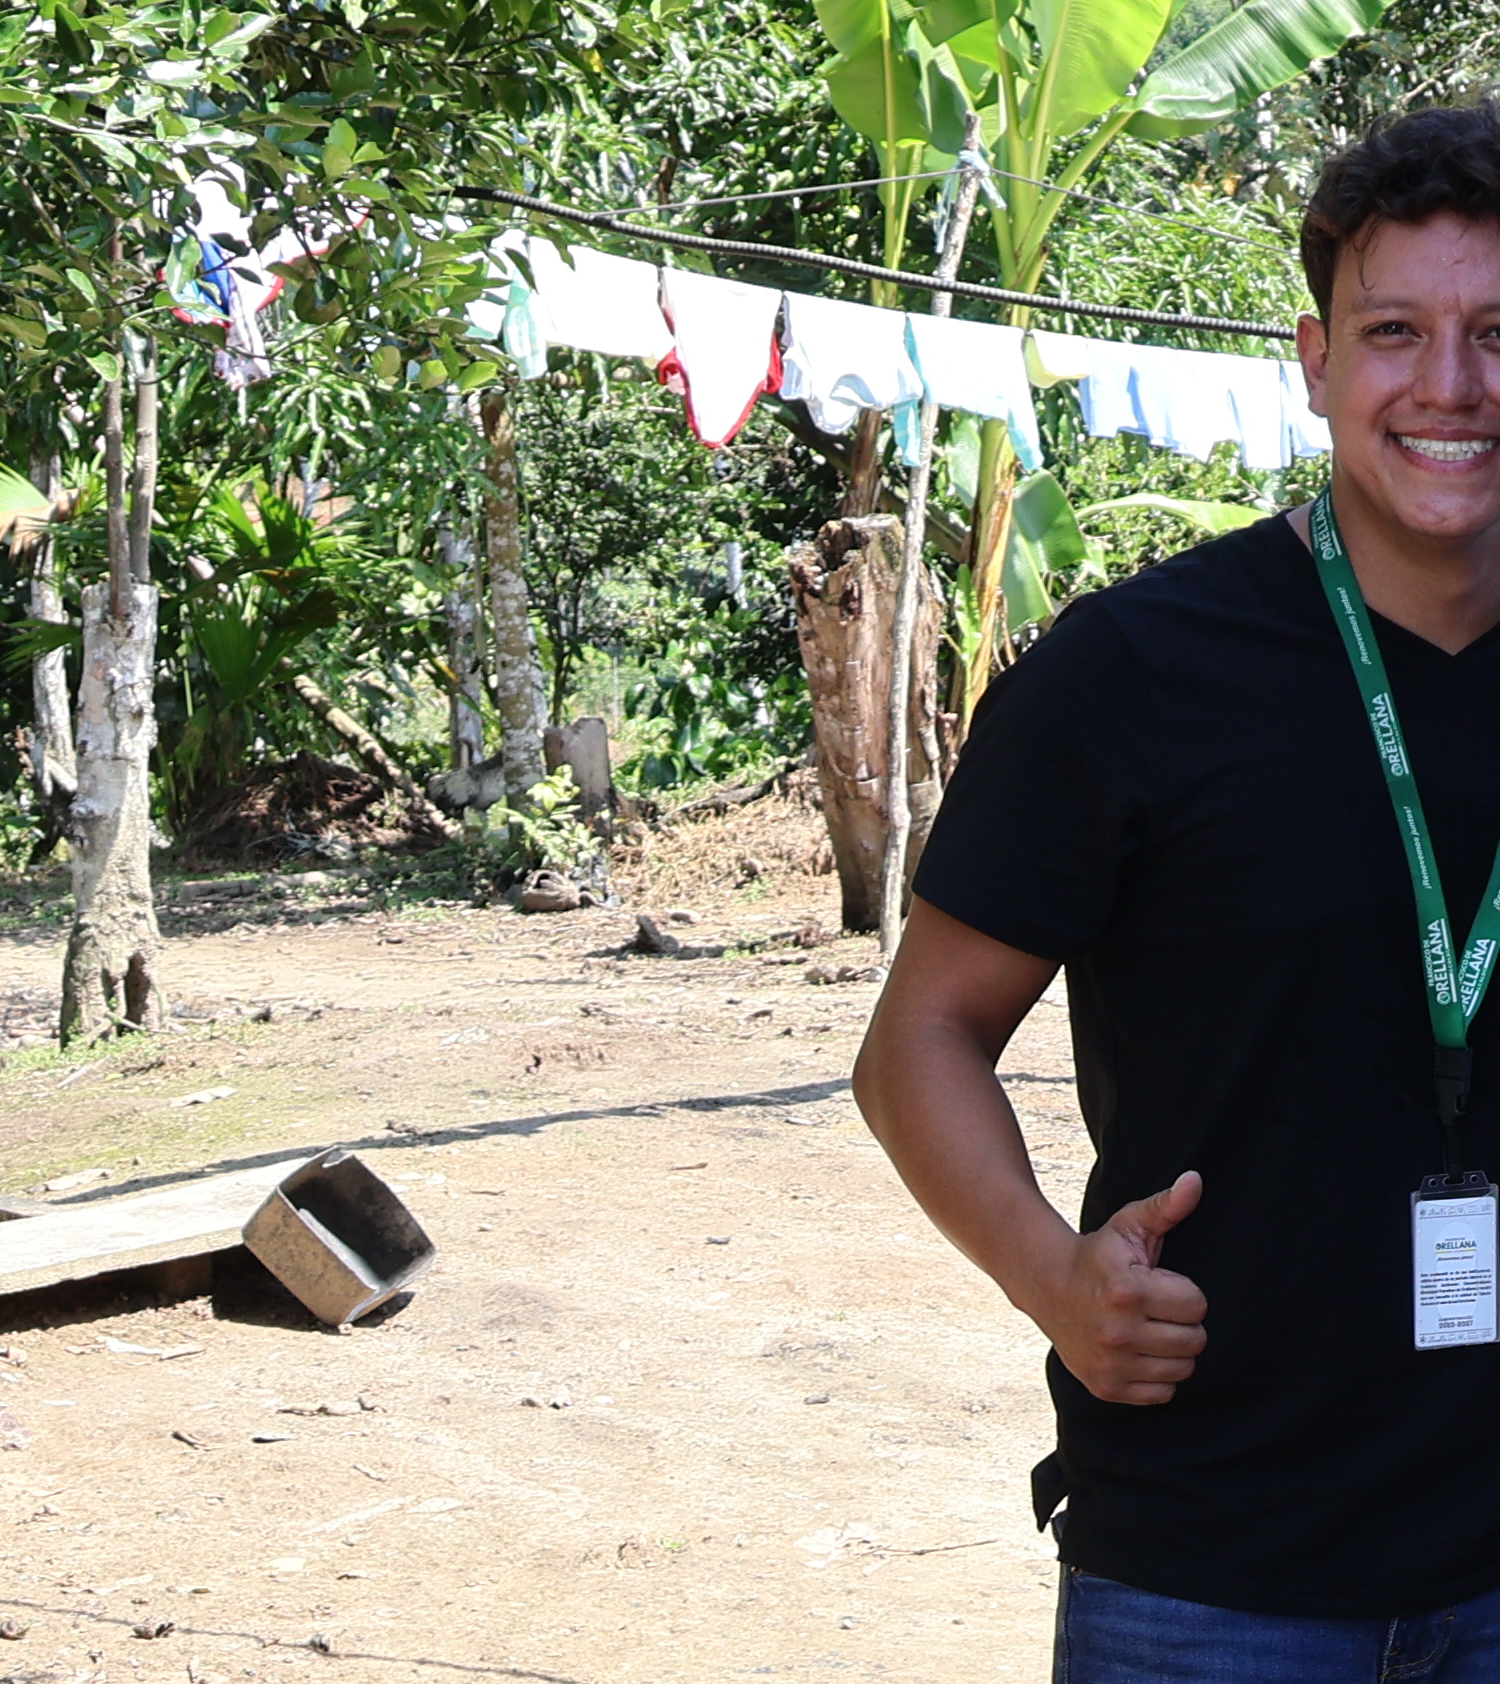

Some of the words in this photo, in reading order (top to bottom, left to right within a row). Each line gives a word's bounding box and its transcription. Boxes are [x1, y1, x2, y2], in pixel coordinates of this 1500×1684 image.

[1372, 693, 1404, 777] ORELLANA
[1424, 949, 1434, 987] FRANCISCO
[1427, 919, 1451, 1005] ORELLANA
[1435, 1240, 1477, 1251] ORELLANA
